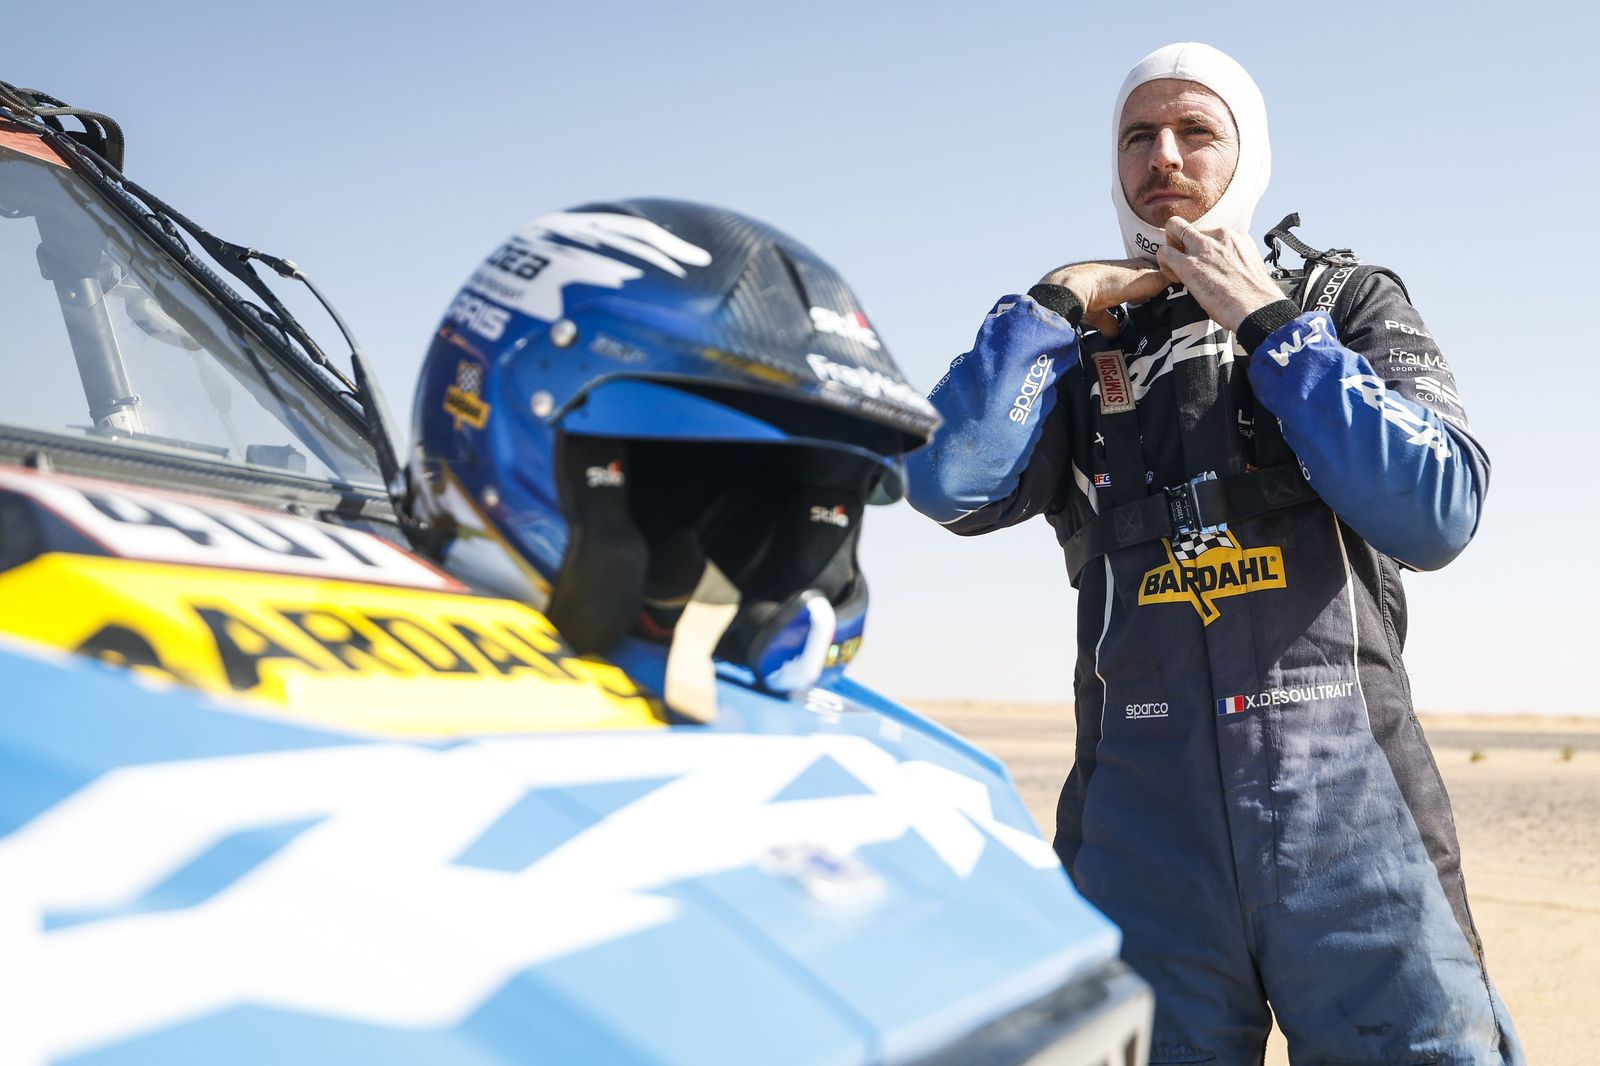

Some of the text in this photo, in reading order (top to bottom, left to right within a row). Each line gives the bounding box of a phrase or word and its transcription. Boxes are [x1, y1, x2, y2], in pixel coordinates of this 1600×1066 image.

[1008, 353, 1052, 426] sparco
[1098, 355, 1124, 404] SIMPSON
[1143, 555, 1279, 605] BARDAHL
[1125, 701, 1169, 720] sparco
[1244, 682, 1354, 710] X.DESOULTRAIT
